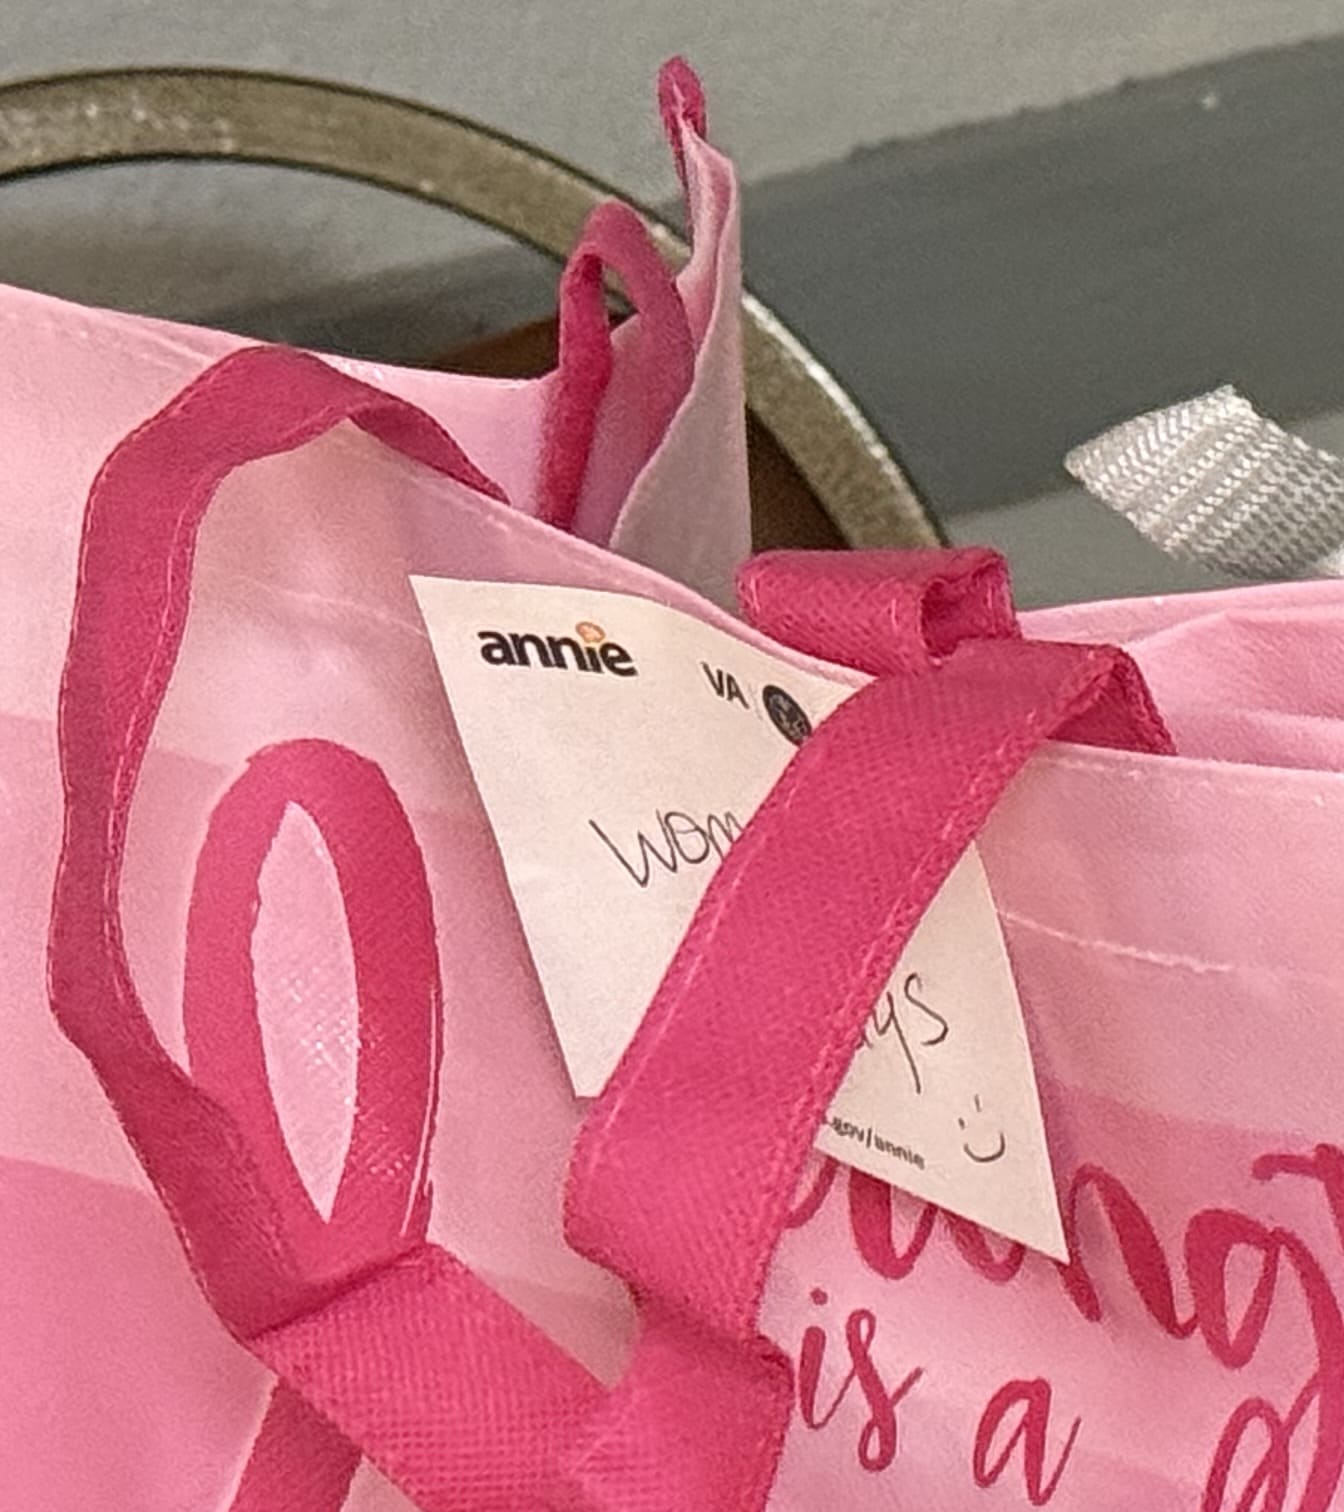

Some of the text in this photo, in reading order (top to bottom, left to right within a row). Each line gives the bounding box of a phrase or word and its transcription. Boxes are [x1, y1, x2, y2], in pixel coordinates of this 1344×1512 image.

[477, 621, 637, 677] annie
[700, 661, 750, 710] VA
[800, 1289, 1081, 1506] is a
